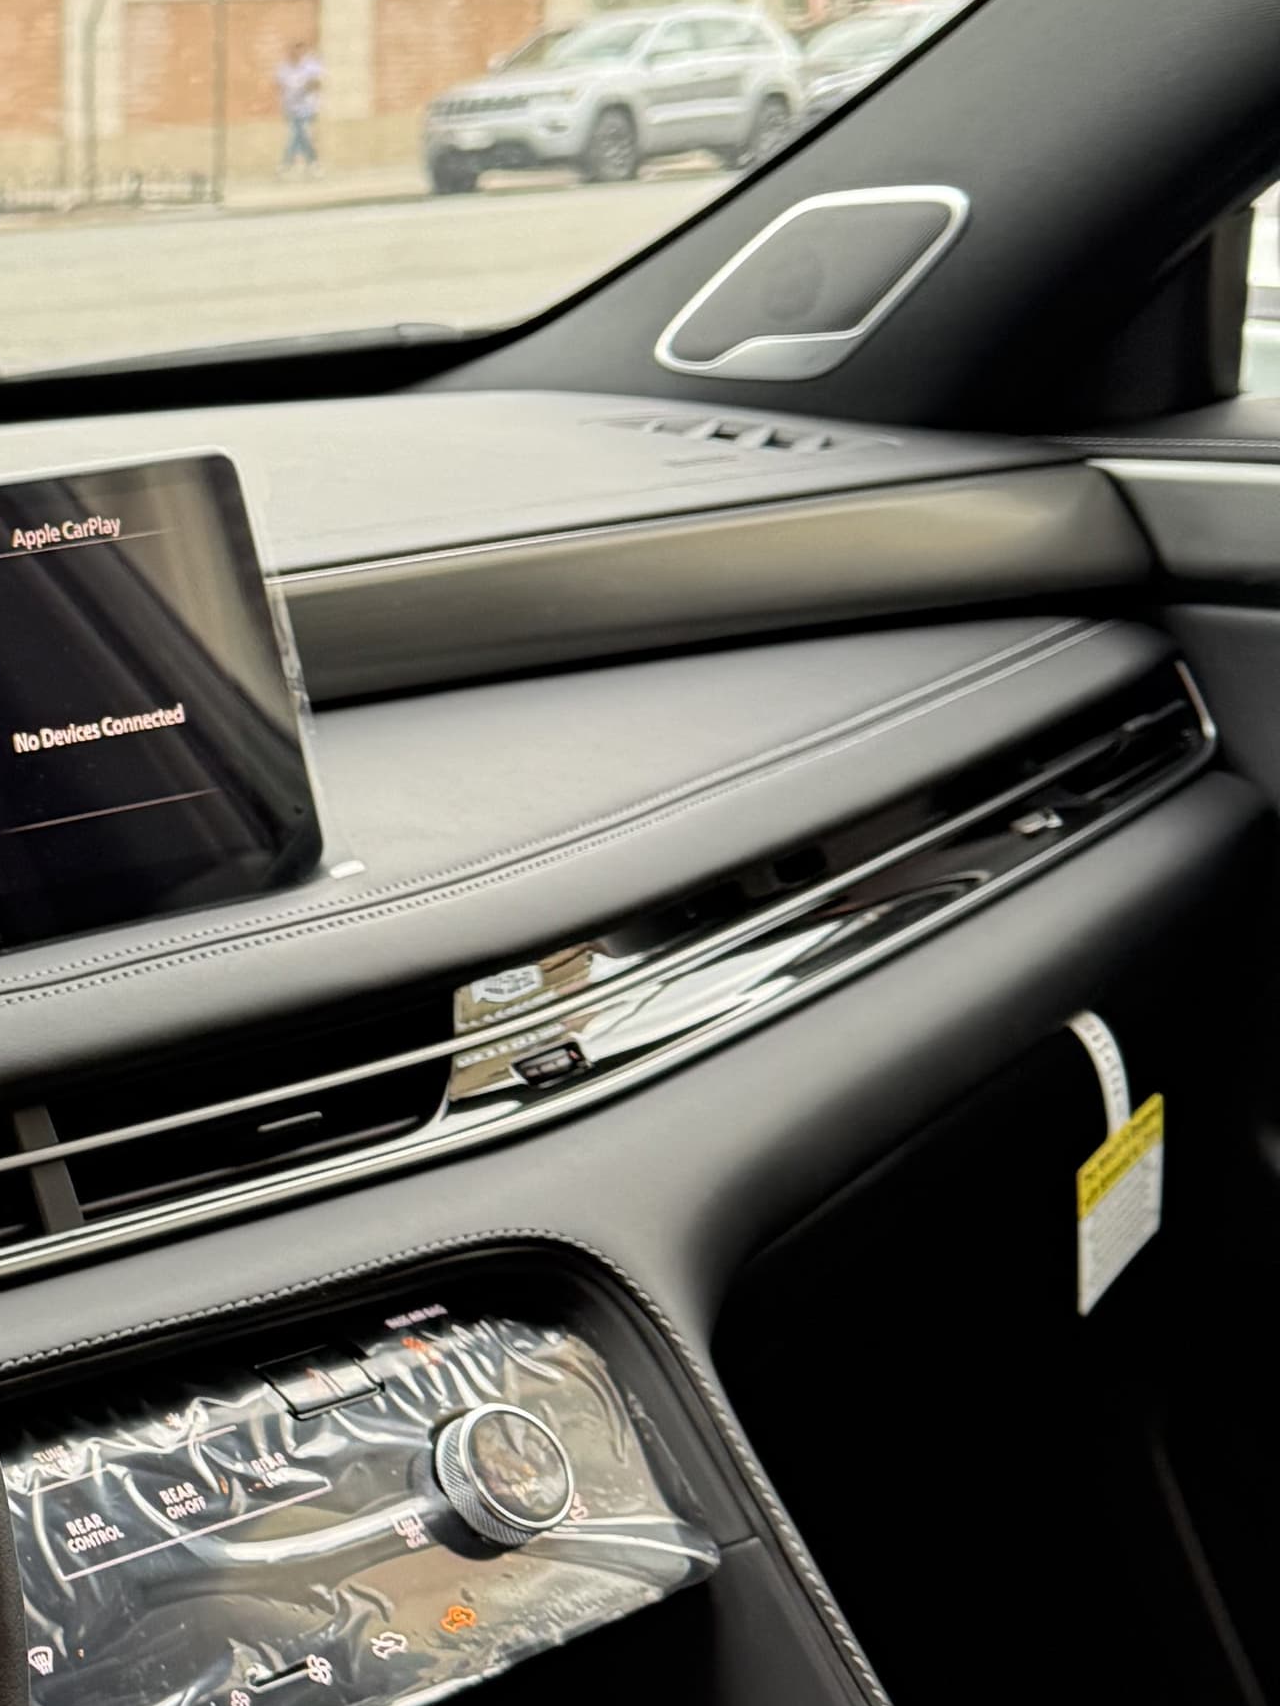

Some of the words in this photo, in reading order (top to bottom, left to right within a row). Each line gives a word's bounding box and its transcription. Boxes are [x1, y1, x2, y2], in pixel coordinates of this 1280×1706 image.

[12, 525, 61, 550] Apple
[62, 515, 121, 542] CarPlay
[13, 733, 39, 754] No
[41, 720, 101, 747] Devices
[103, 703, 186, 736] Connected
[159, 1482, 198, 1505] REAR
[65, 1513, 105, 1537] REAR
[67, 1524, 124, 1554] CONTROL
